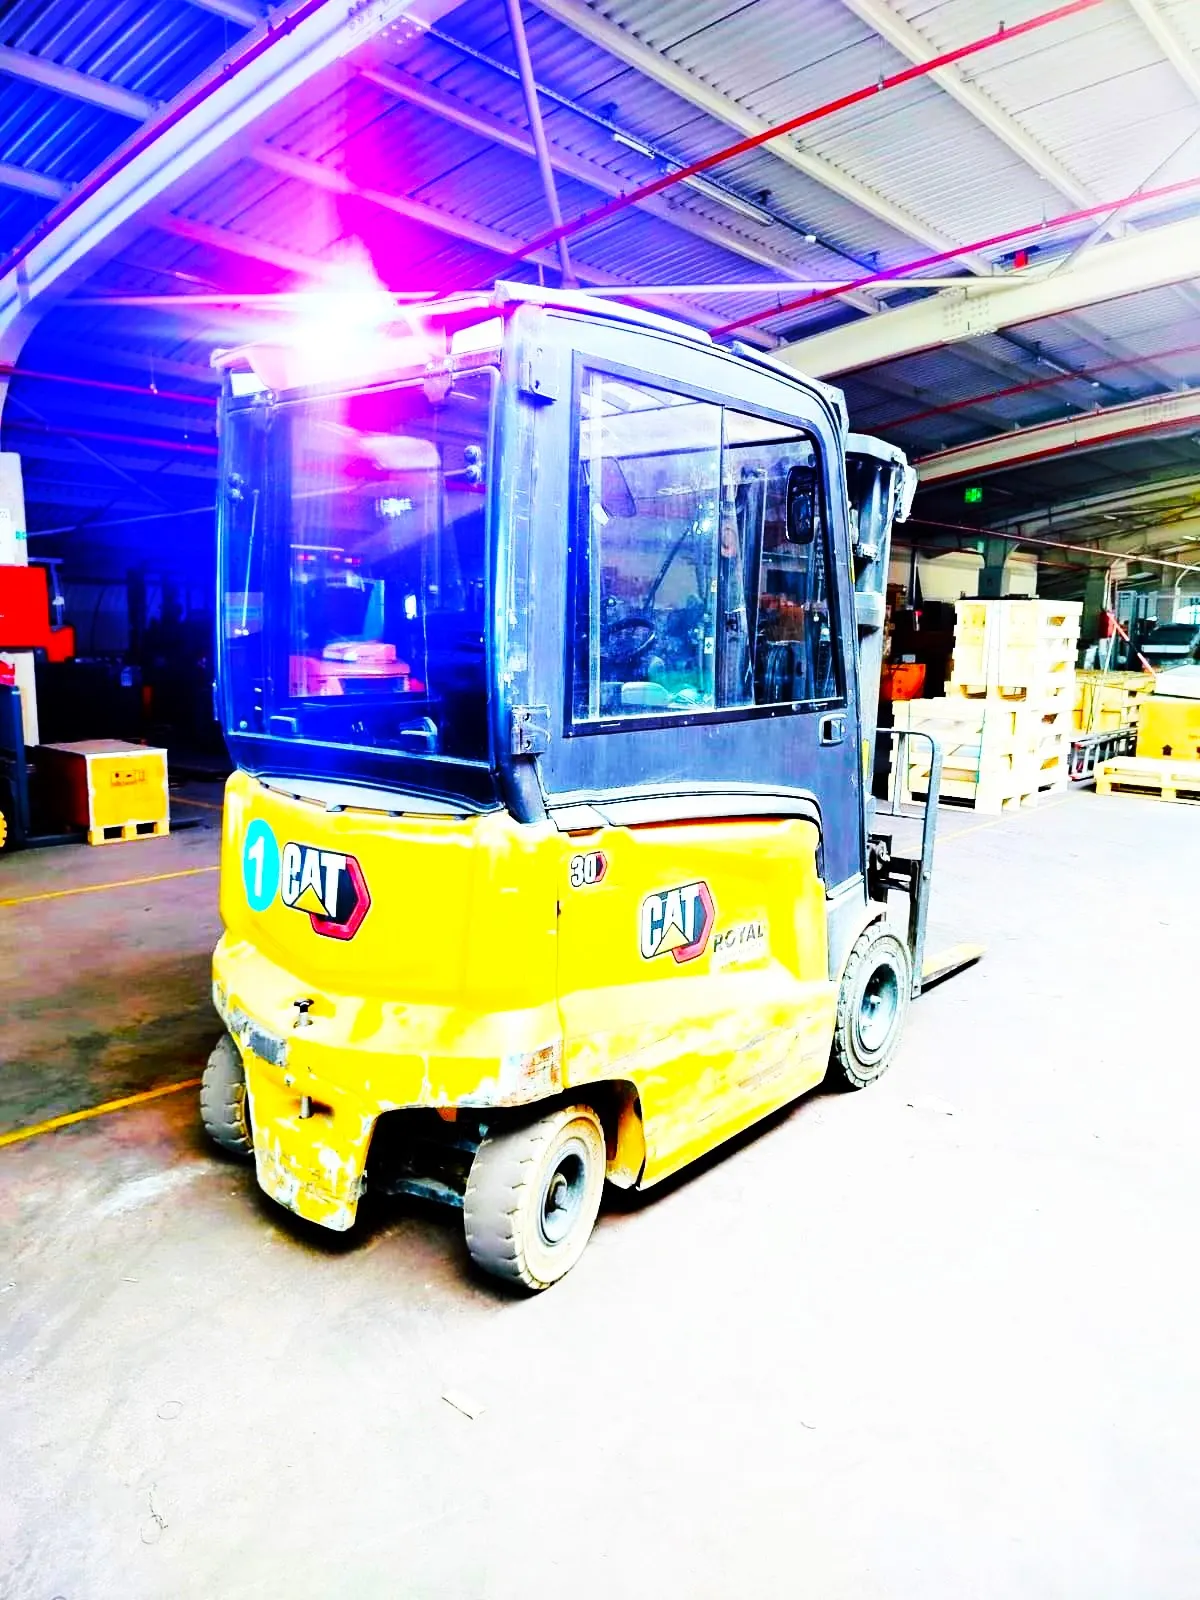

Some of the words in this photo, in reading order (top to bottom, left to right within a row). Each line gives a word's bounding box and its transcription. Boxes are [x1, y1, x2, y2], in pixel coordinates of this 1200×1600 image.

[248, 836, 265, 897] 1
[281, 842, 347, 918] CAT
[570, 850, 598, 887] 30
[641, 882, 702, 960] CAT
[713, 923, 764, 953] ROYAL
